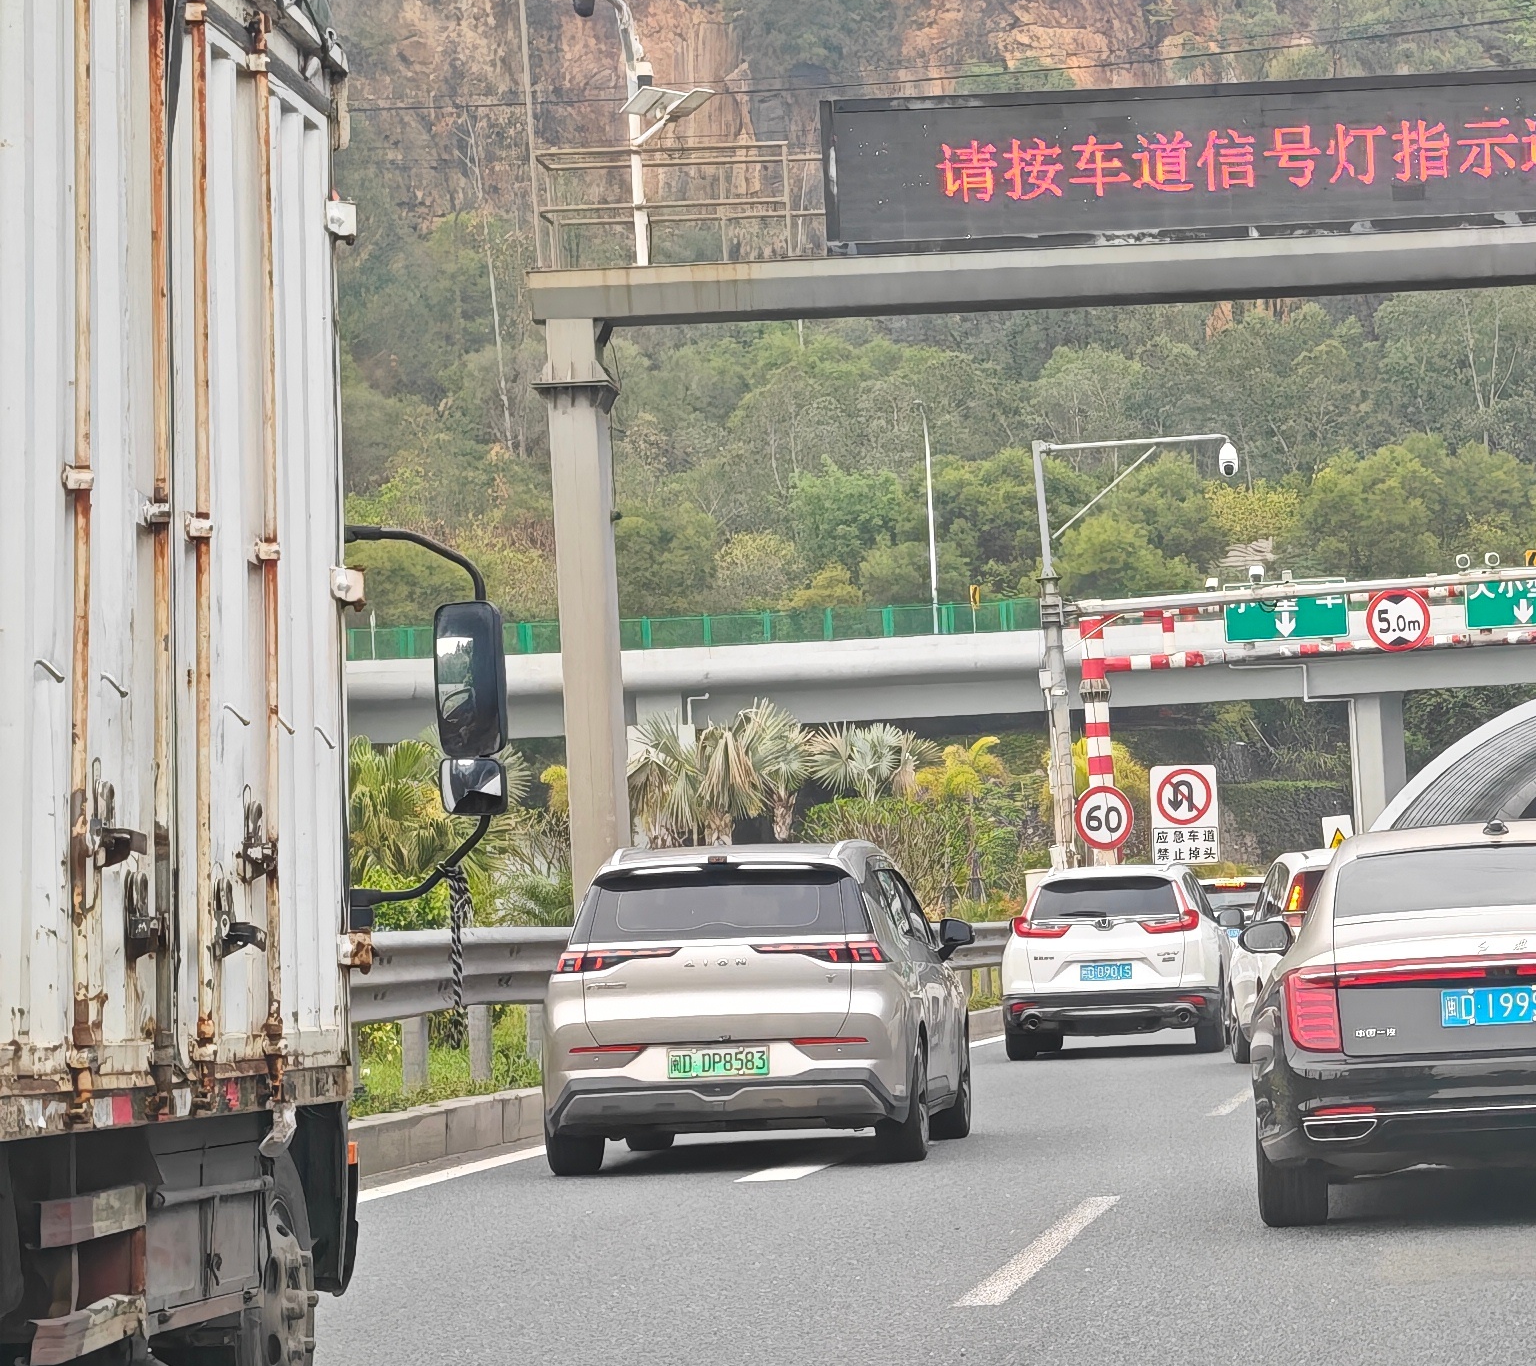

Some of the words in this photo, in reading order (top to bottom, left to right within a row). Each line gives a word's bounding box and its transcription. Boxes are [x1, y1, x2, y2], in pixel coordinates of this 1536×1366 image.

[1377, 608, 1421, 635] 5.0m
[1085, 804, 1123, 834] 60
[1156, 829, 1216, 844] 应急车道
[1157, 846, 1217, 862] 禁止掉头
